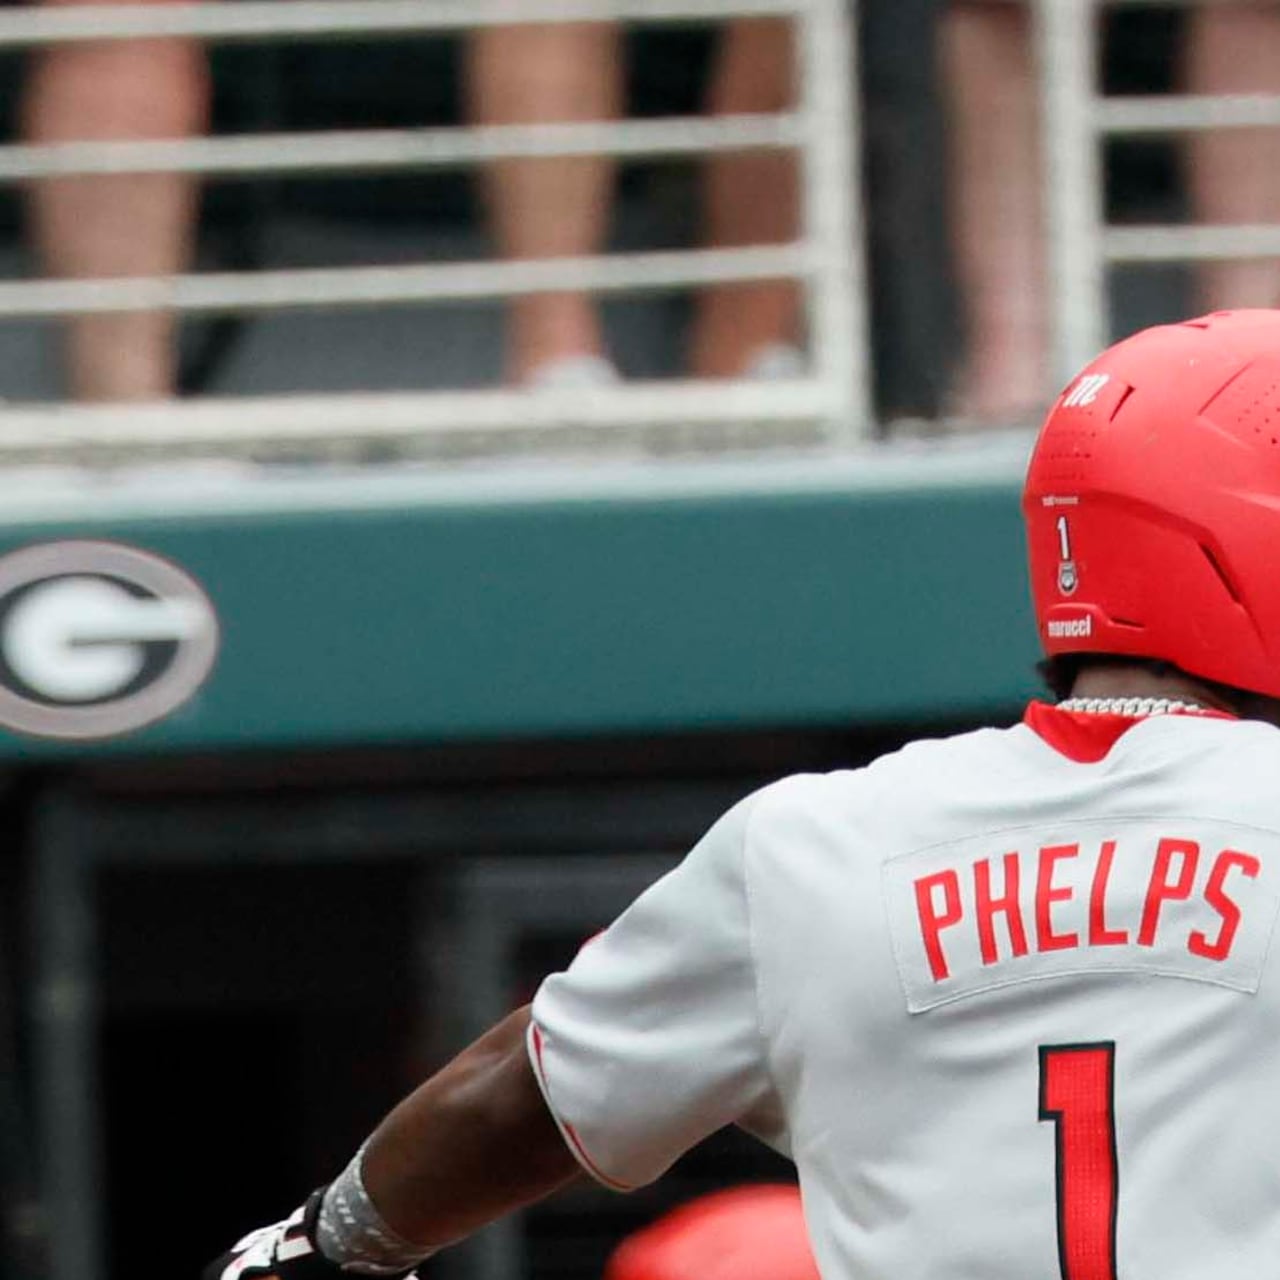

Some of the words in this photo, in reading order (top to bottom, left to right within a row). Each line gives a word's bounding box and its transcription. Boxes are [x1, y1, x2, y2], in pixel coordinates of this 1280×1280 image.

[1057, 515, 1071, 561] 1
[0, 570, 206, 707] G
[913, 837, 1261, 982] PHELPS
